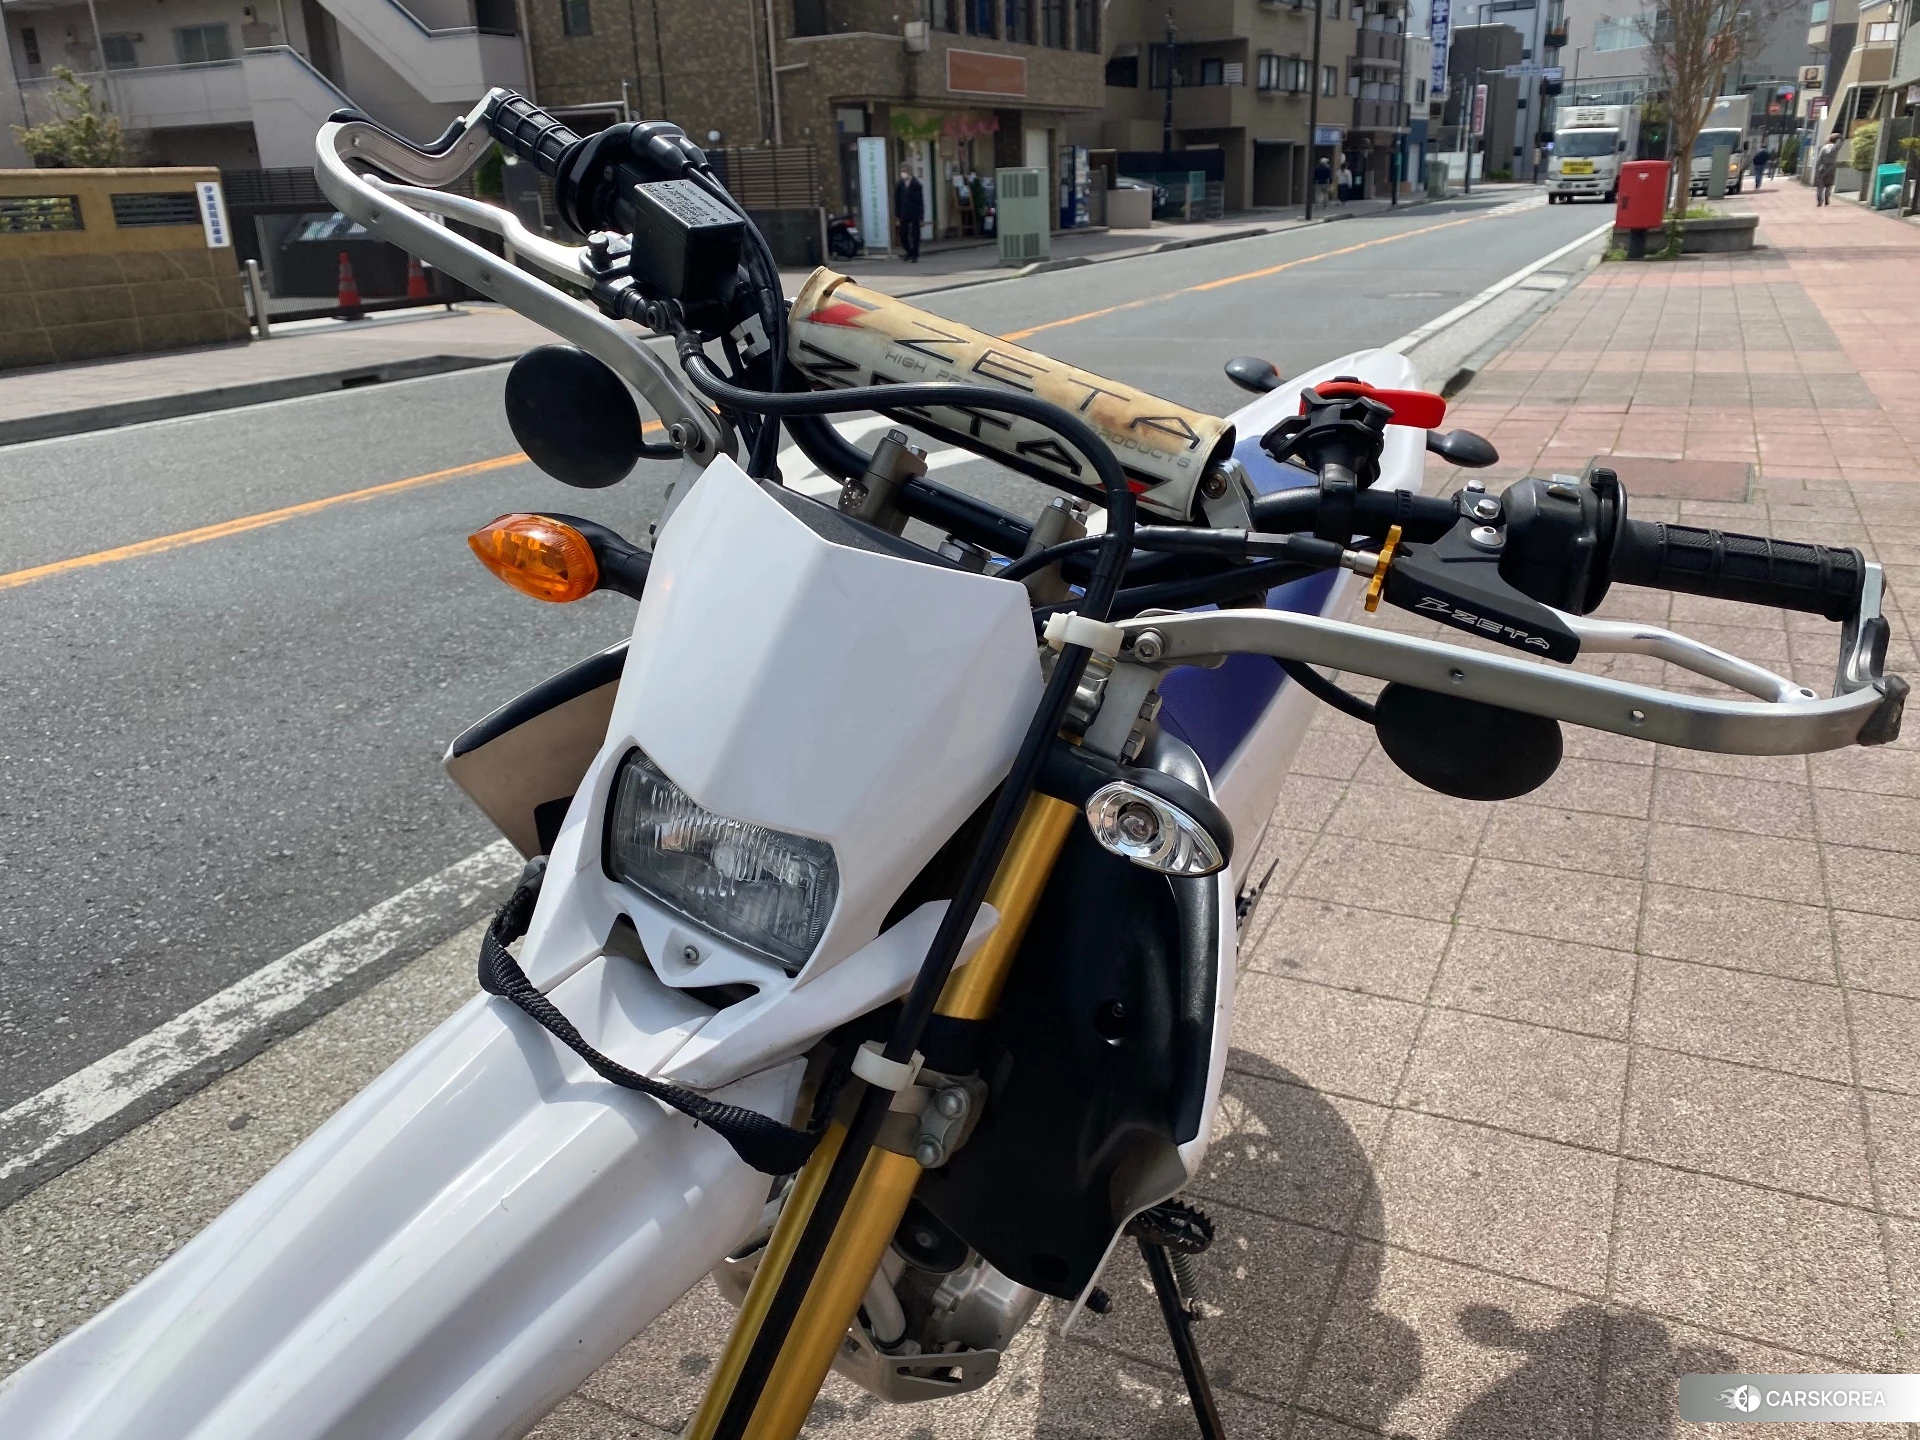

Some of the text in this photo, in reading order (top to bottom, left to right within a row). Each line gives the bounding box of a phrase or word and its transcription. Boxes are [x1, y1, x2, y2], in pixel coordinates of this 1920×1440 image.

[885, 351, 927, 373] HIGH
[893, 320, 1201, 450] ZETA
[1451, 609, 1550, 650] ZETA
